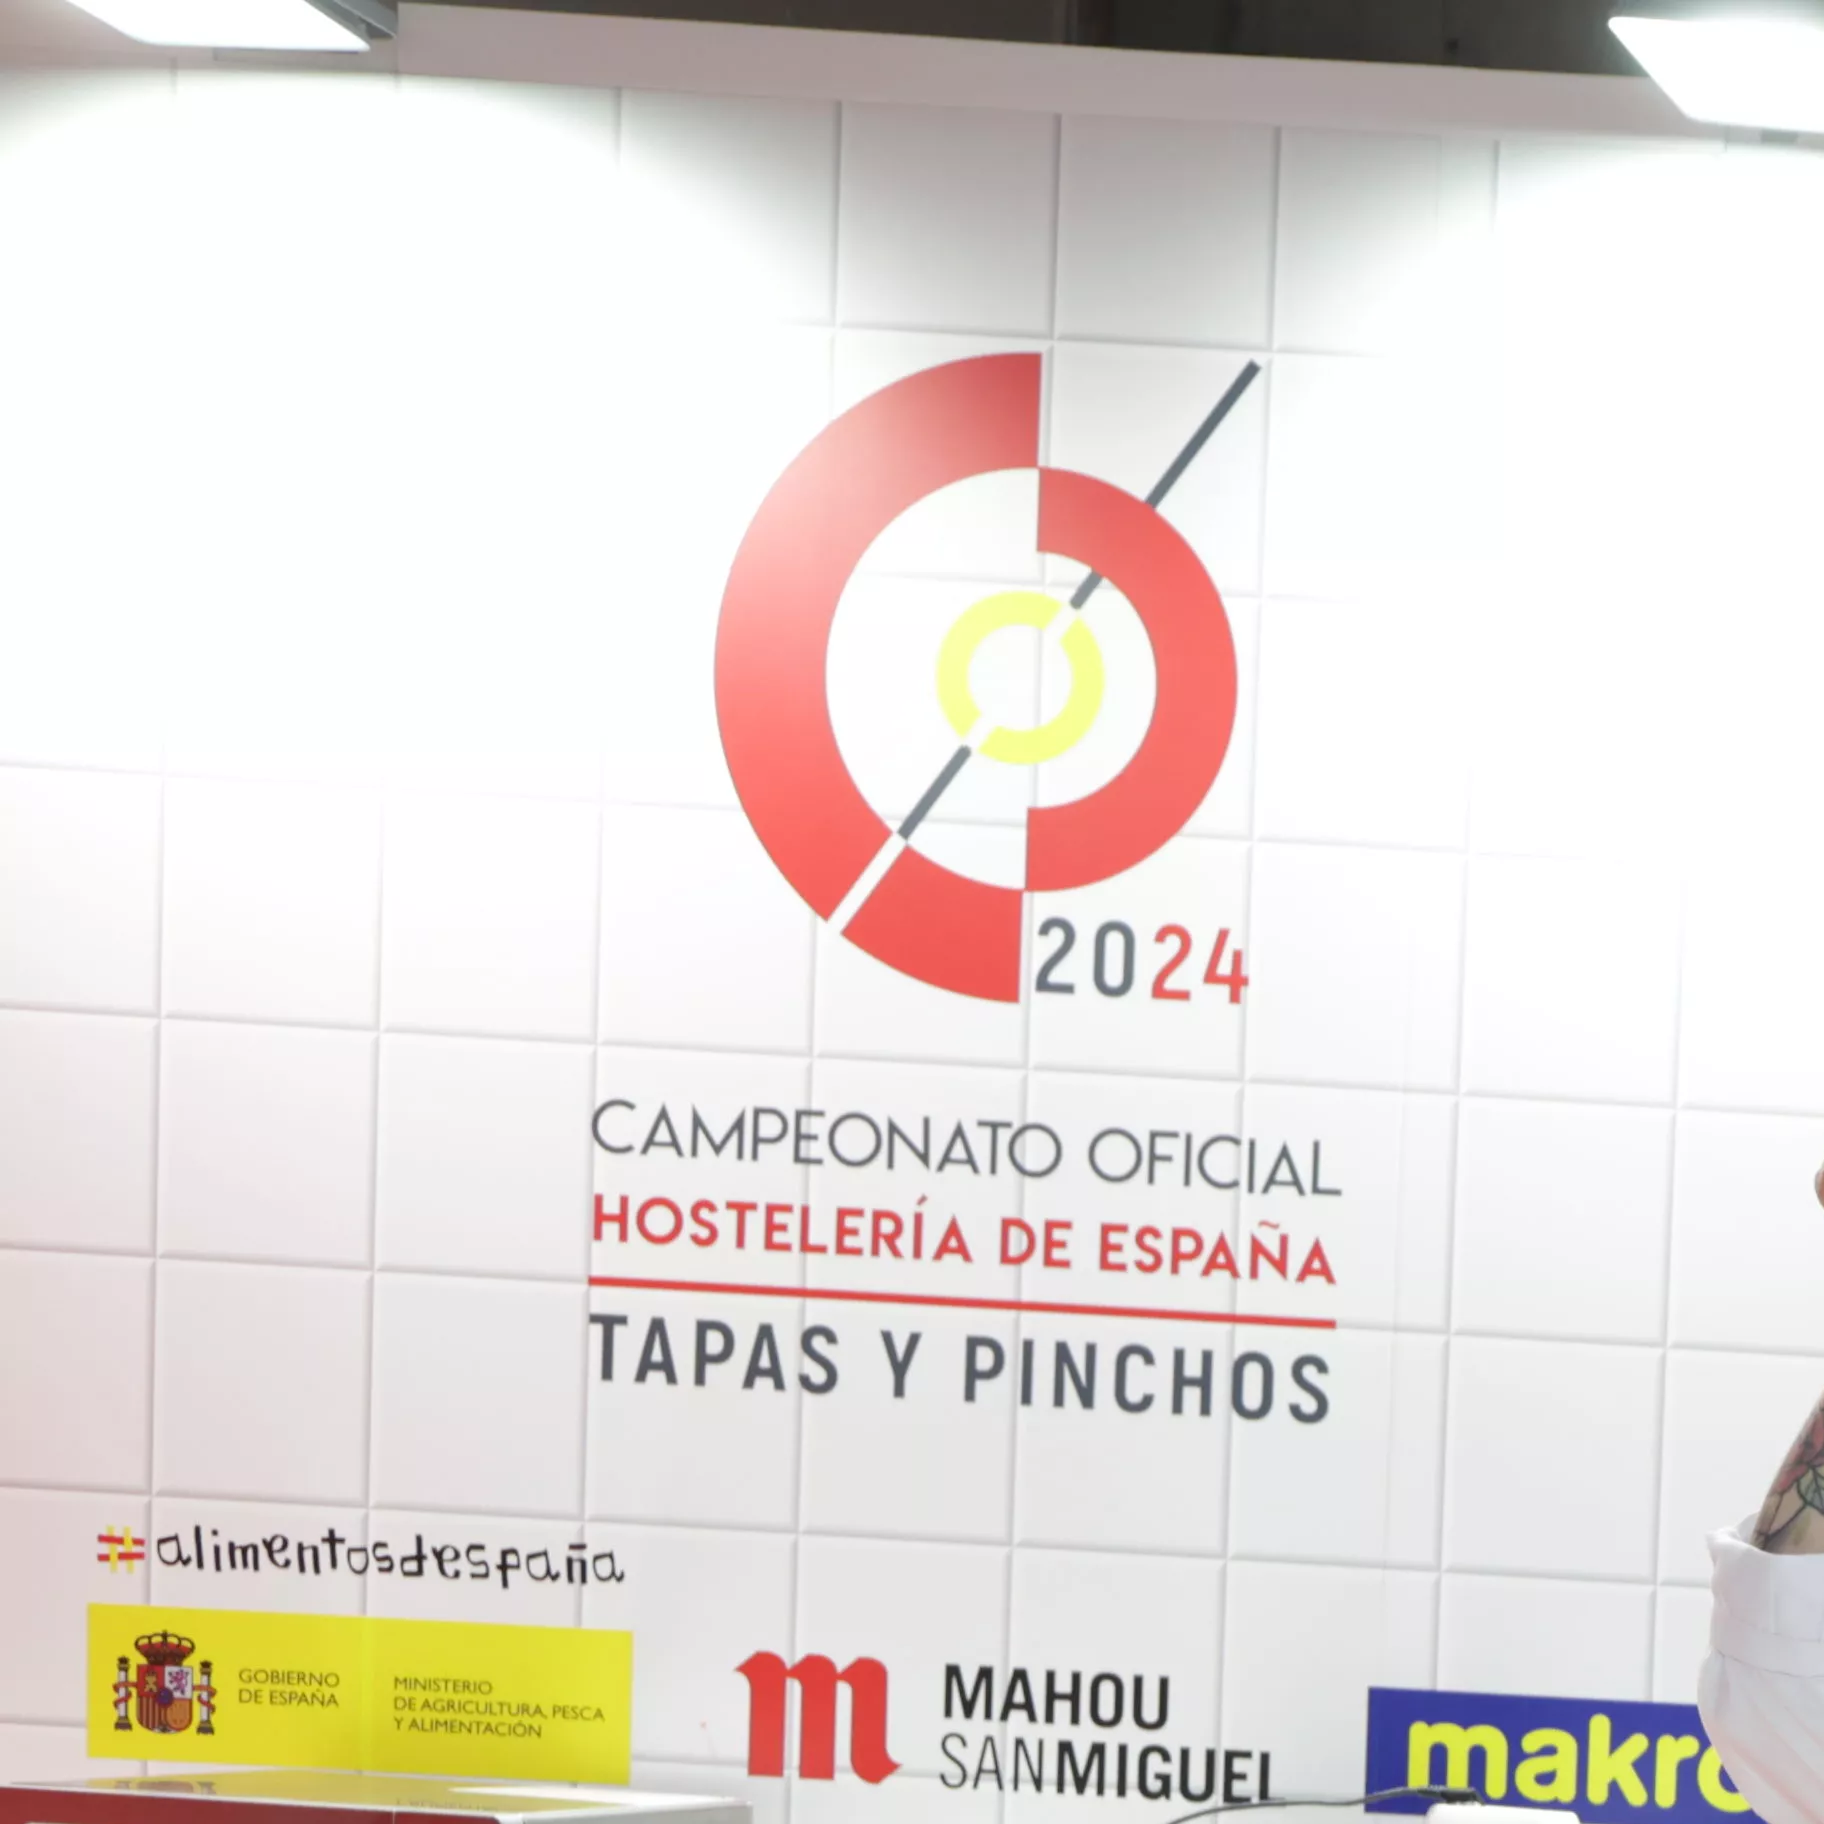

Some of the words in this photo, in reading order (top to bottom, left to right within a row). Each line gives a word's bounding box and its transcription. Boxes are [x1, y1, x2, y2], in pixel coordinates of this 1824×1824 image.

[1036, 919, 1249, 1003] 2024
[592, 1100, 1061, 1178] CAMPEONATO
[1089, 1127, 1341, 1196] OFICIAL
[592, 1195, 973, 1262] HOSTELERÍA
[1000, 1217, 1073, 1269] DE
[1100, 1220, 1336, 1285] ESPAÑA
[589, 1314, 839, 1394] TAPAS
[881, 1330, 922, 1399] Y
[965, 1335, 1329, 1424] PINCHOS
[238, 1669, 339, 1689] GOBIERNO
[238, 1687, 264, 1706] DE
[269, 1687, 339, 1709] ESPAÑA
[394, 1677, 492, 1696] MINISTERIO
[943, 1664, 1170, 1730] MAHOU
[394, 1696, 415, 1713] DE
[551, 1706, 605, 1723] PESCA
[394, 1716, 403, 1731] Y
[407, 1715, 542, 1739] ALIMENTACIÓN
